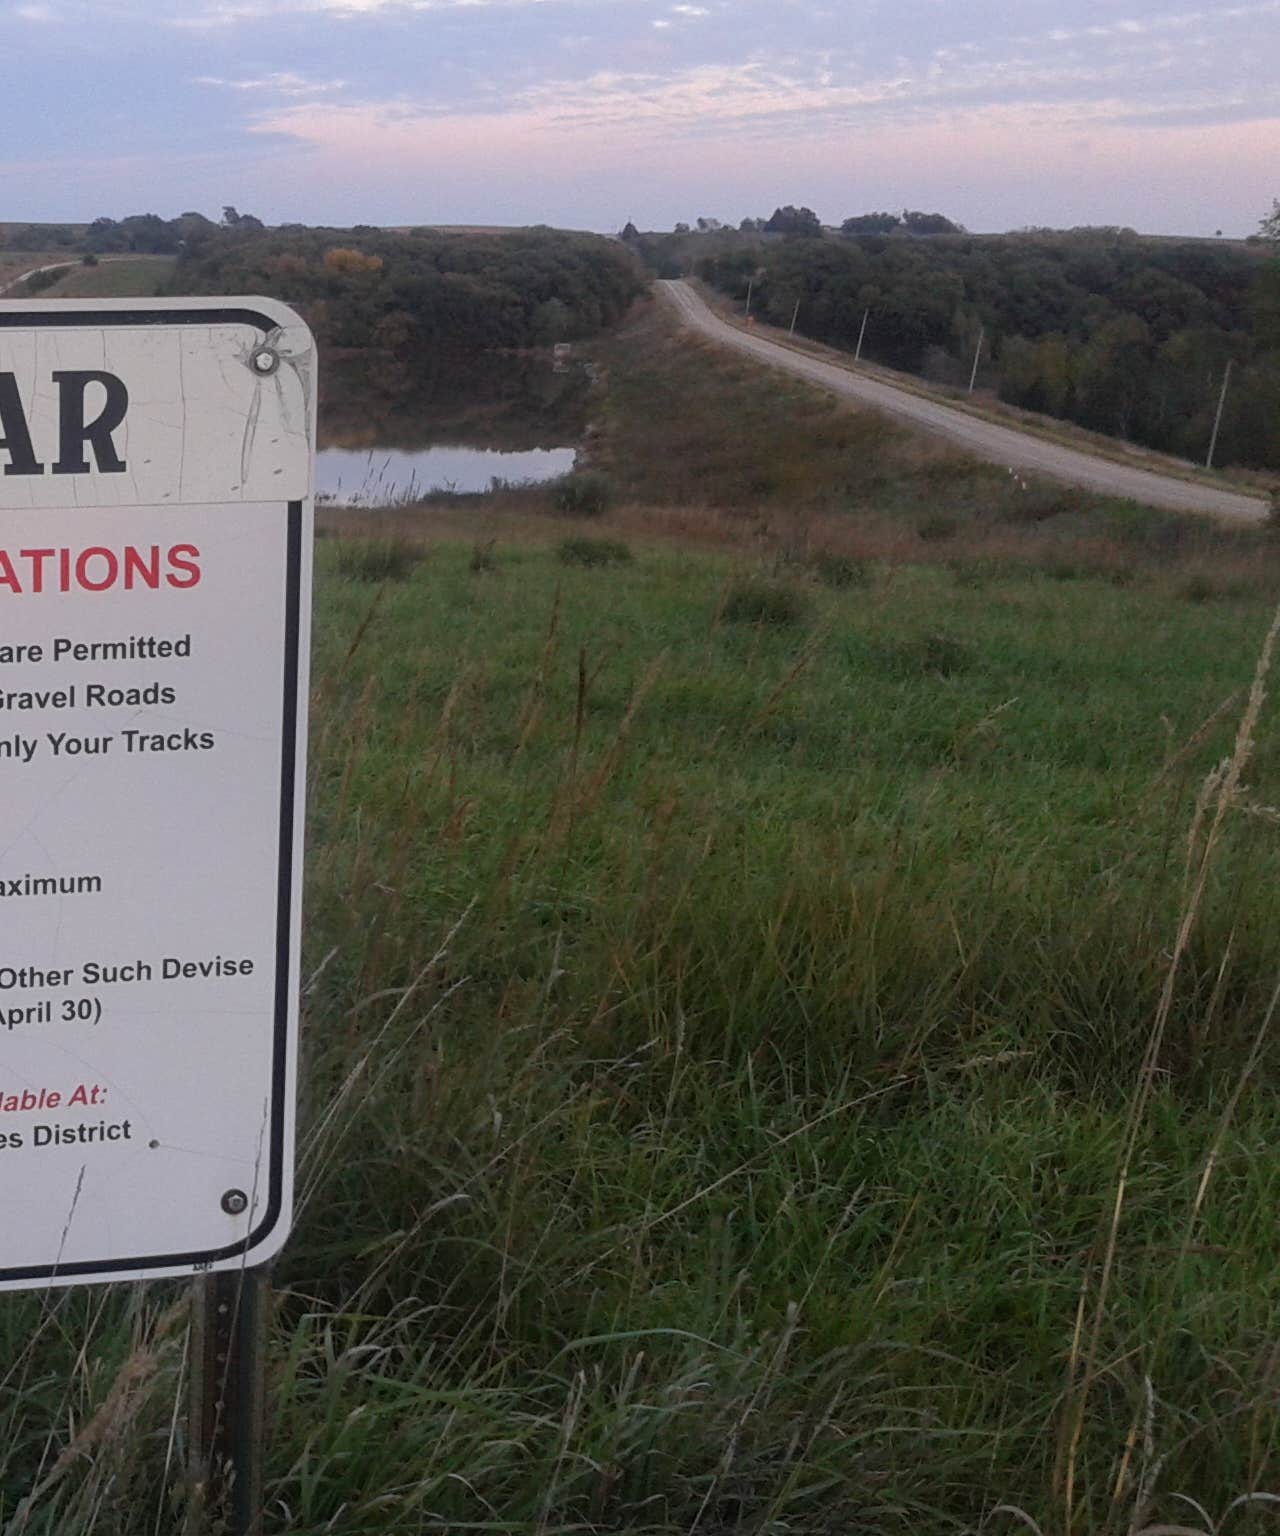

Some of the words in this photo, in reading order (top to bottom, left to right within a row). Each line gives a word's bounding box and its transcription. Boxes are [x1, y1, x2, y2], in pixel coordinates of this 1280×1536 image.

[53, 633, 191, 663] Permitted
[85, 681, 177, 708] Roads
[45, 731, 115, 757] Your
[120, 727, 215, 753] Tracks
[81, 959, 152, 985] Such
[161, 954, 254, 980] Devise
[60, 996, 103, 1026] 30)
[66, 1083, 108, 1108] At:
[33, 1119, 132, 1148] District
